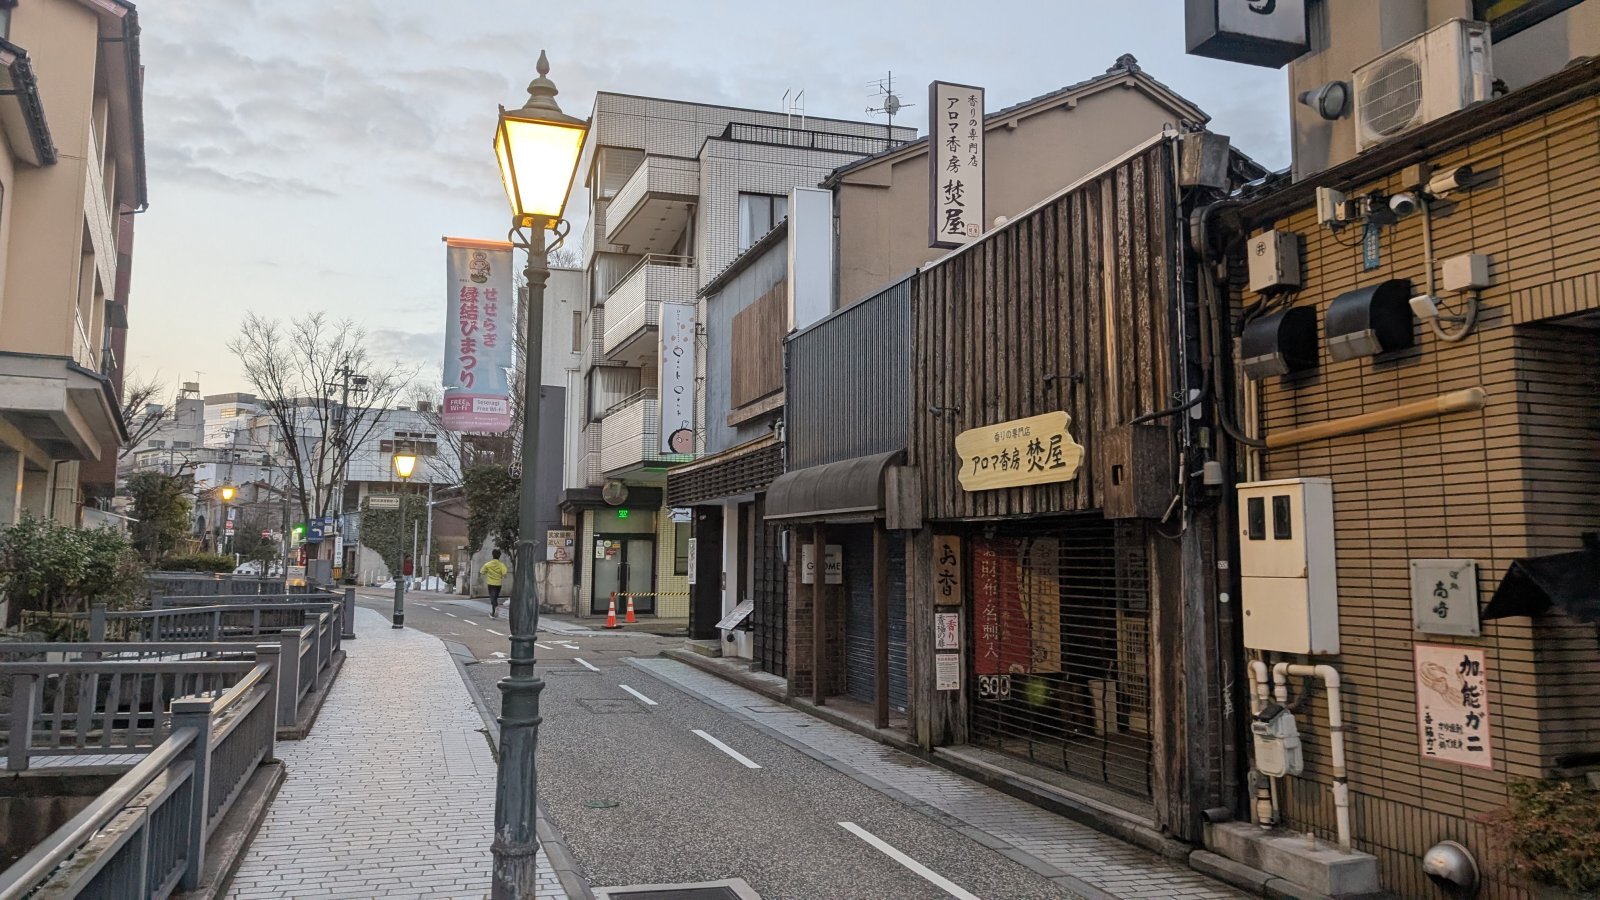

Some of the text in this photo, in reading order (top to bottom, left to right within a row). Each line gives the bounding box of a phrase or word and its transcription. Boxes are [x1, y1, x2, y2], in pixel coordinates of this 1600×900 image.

[967, 94, 978, 167] 香りの専門店
[941, 97, 966, 237] アロマ香房 焚屋
[459, 285, 479, 390] 縁結びまつり
[482, 287, 498, 348] せせらぎ
[971, 447, 1021, 476] アロマ香房
[994, 426, 1031, 443] 香りの専門店
[938, 543, 958, 597] お香
[946, 619, 957, 643] 香り
[1459, 654, 1485, 752] 加能ガニ
